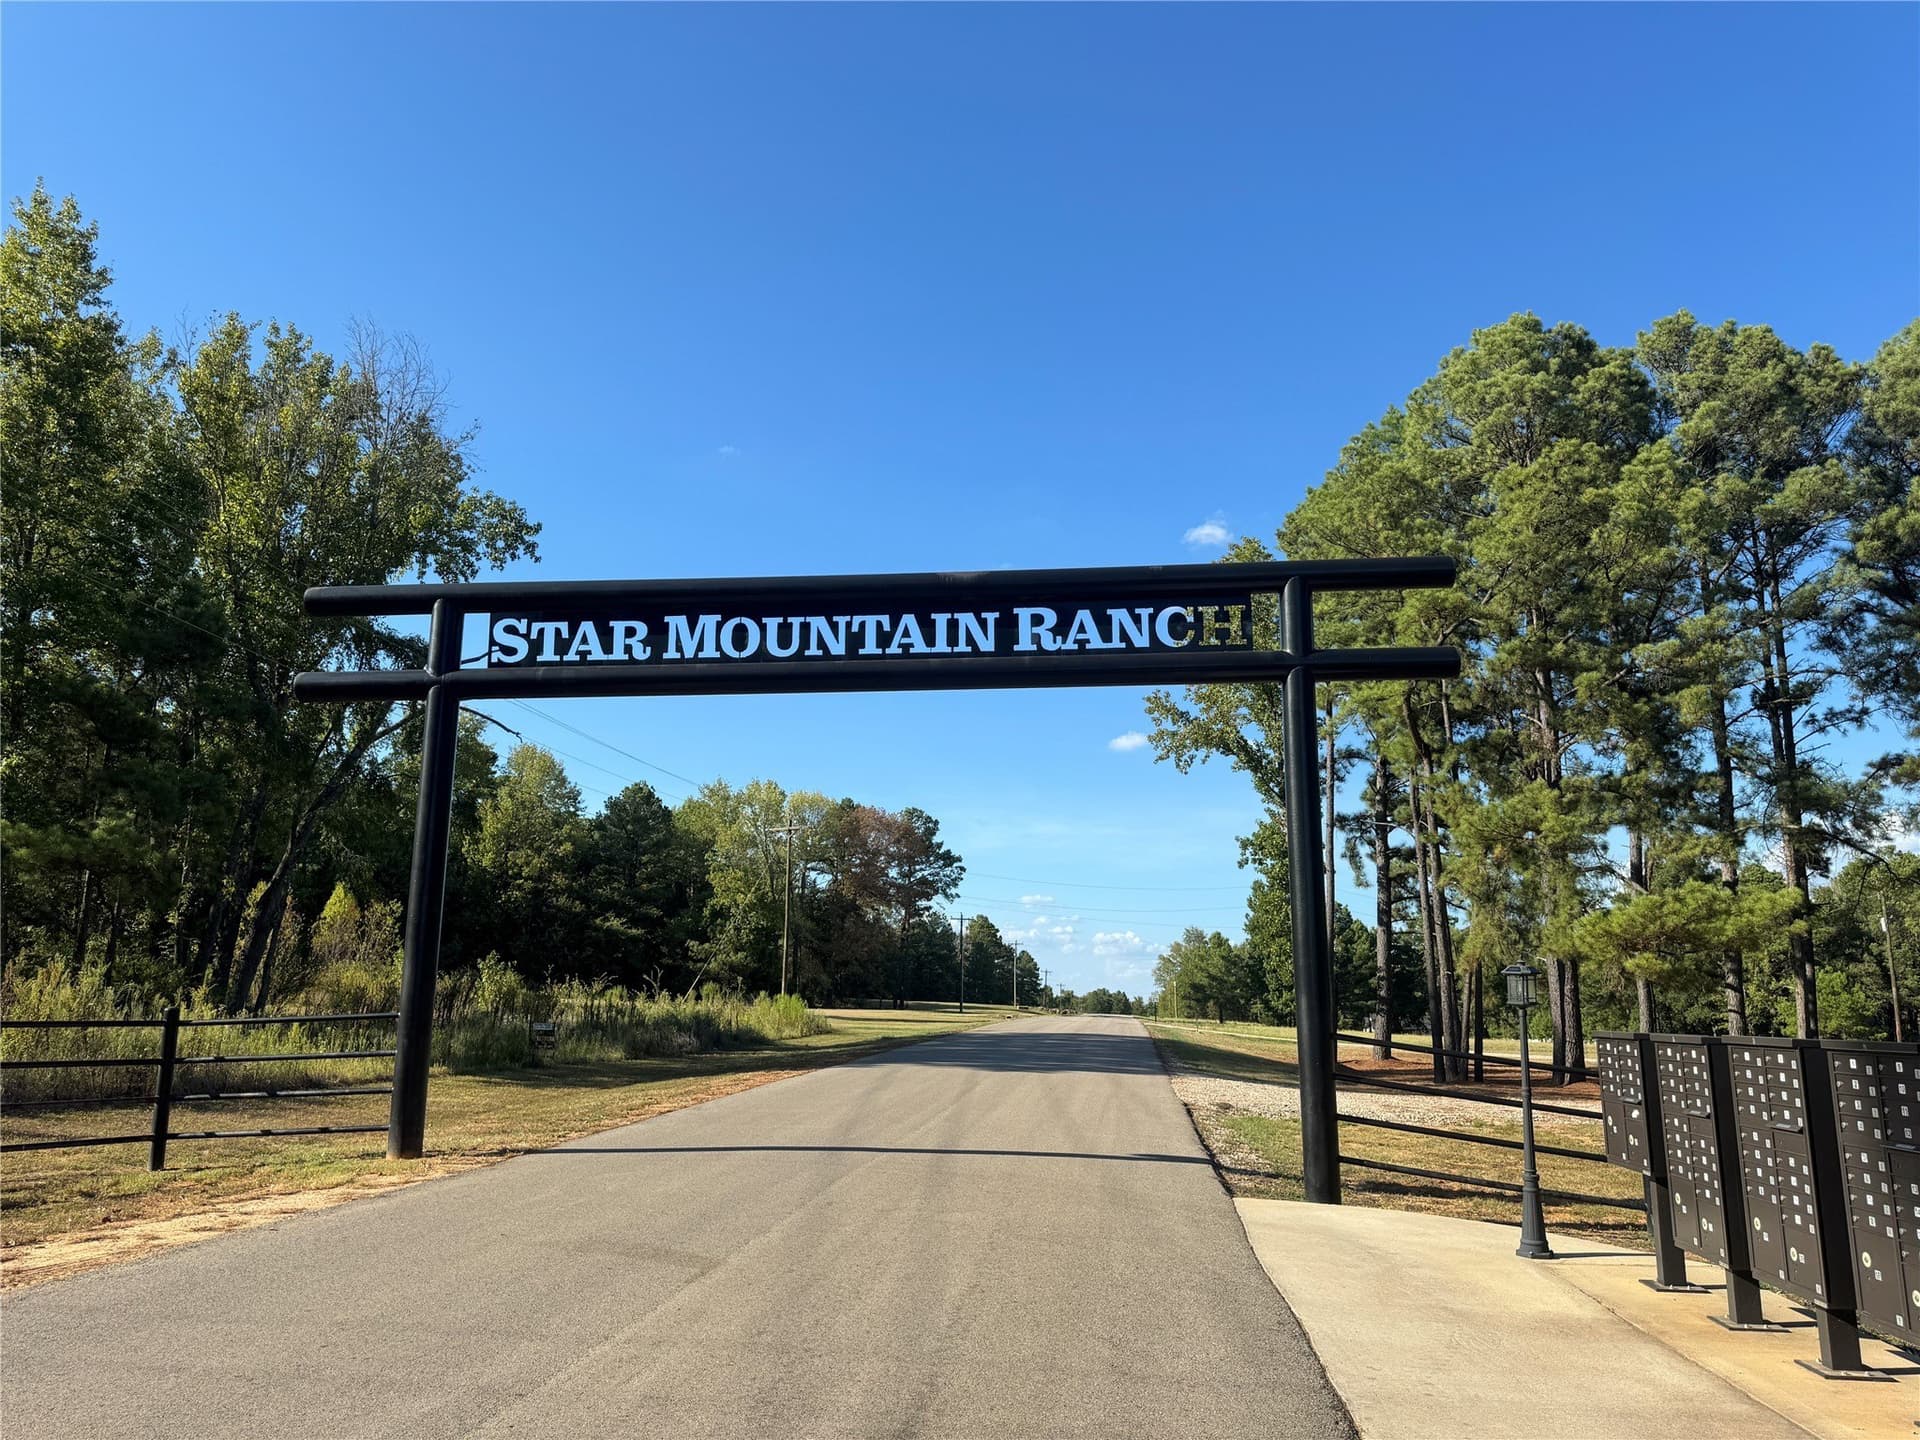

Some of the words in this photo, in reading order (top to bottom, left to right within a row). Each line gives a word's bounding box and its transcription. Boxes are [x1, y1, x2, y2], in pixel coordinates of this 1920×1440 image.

[491, 618, 651, 664] STAR
[663, 611, 999, 660] MOUNTAIN
[1013, 604, 1247, 652] RANCH
